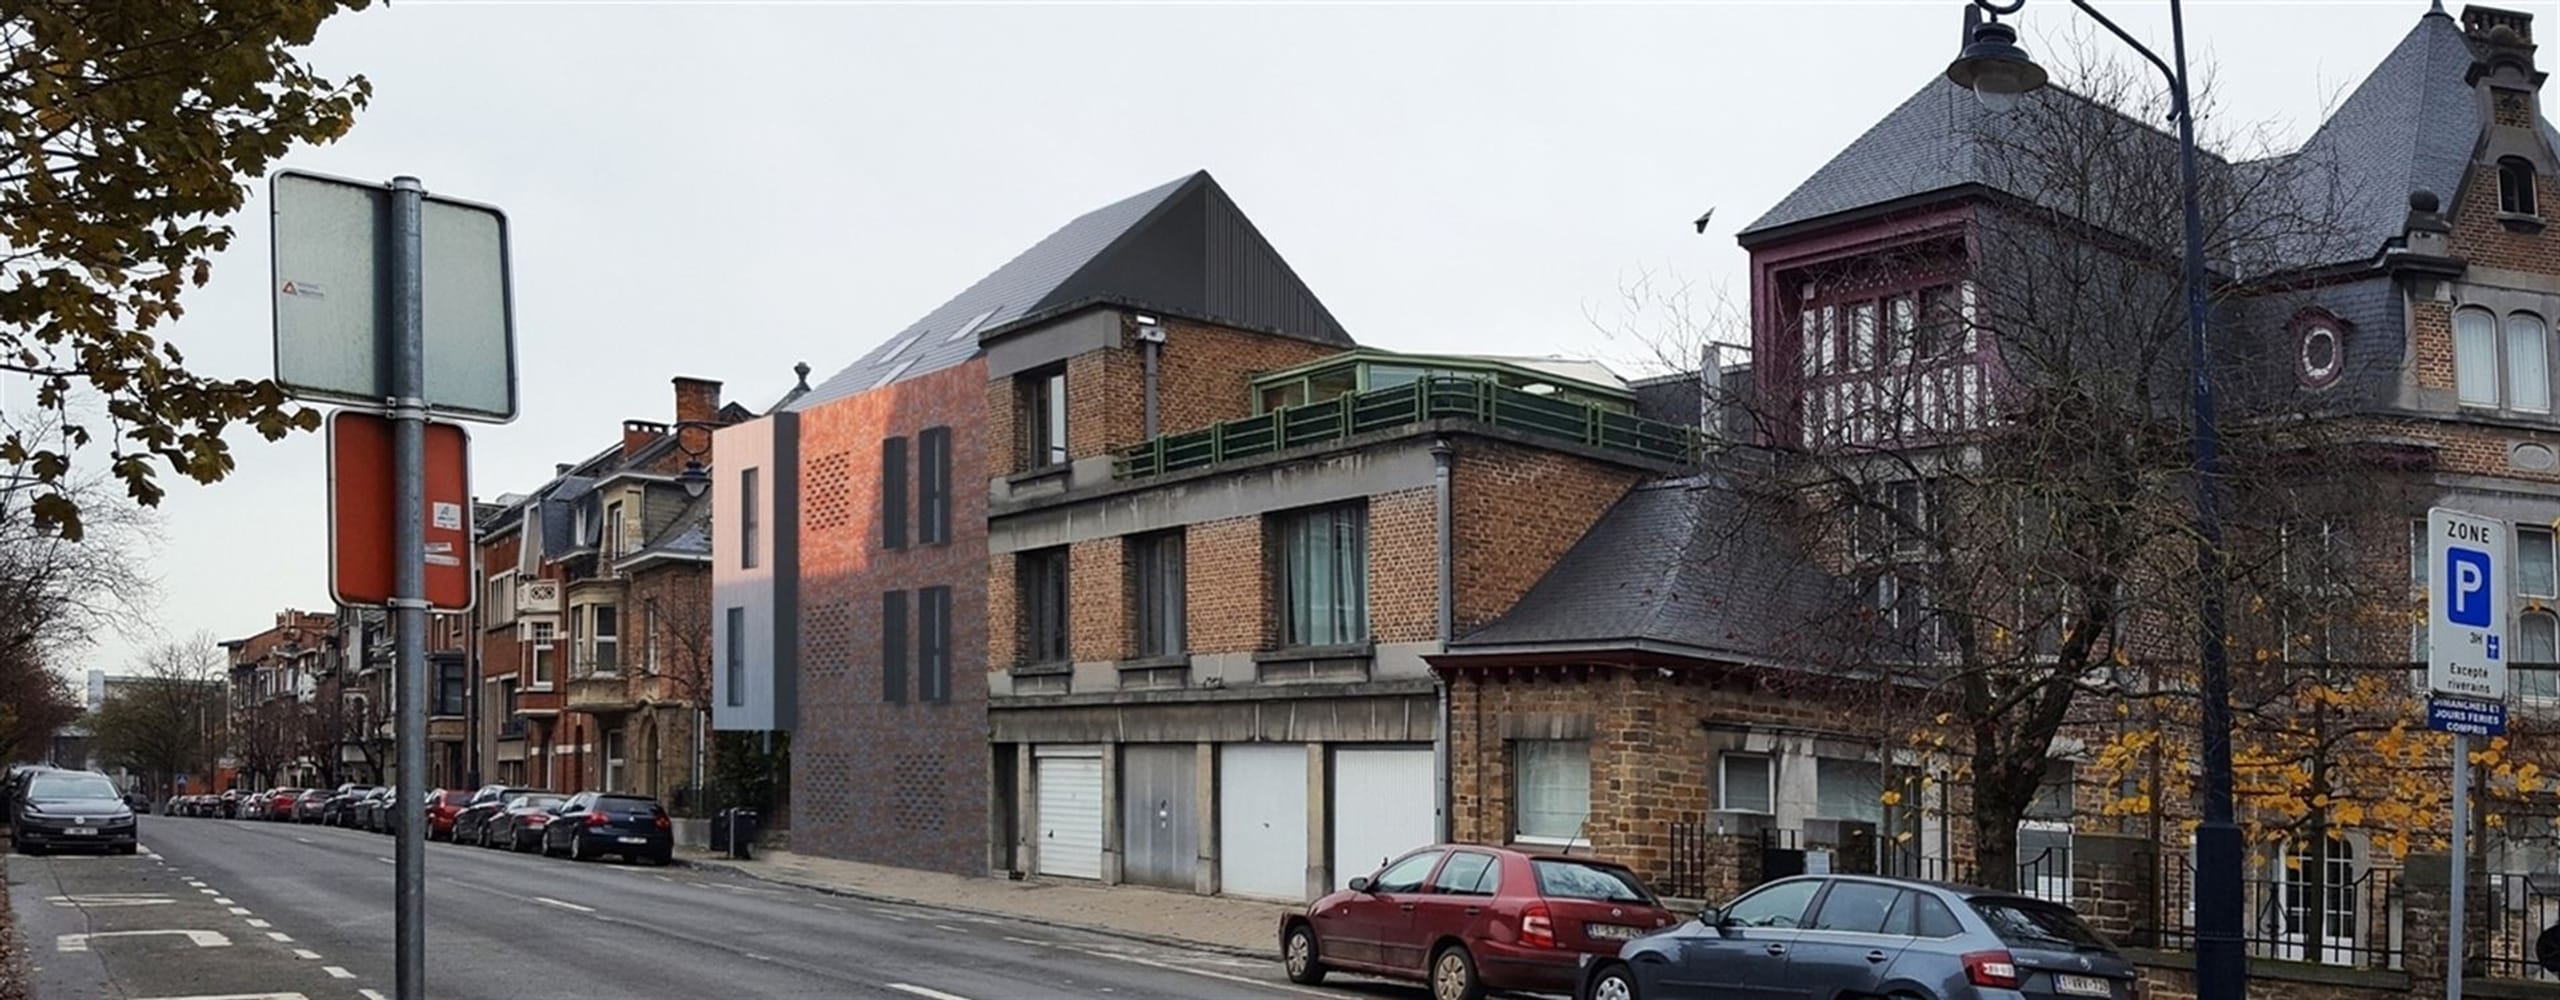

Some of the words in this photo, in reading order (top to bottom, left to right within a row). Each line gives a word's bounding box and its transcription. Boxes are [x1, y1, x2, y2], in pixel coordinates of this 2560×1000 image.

[2447, 520, 2490, 544] ZONE
[2456, 560, 2482, 613] P
[2470, 632, 2483, 644] 3H
[2448, 680, 2490, 694] riverains
[2435, 709, 2466, 721] JOURS
[2446, 722, 2488, 735] COMPRIS
